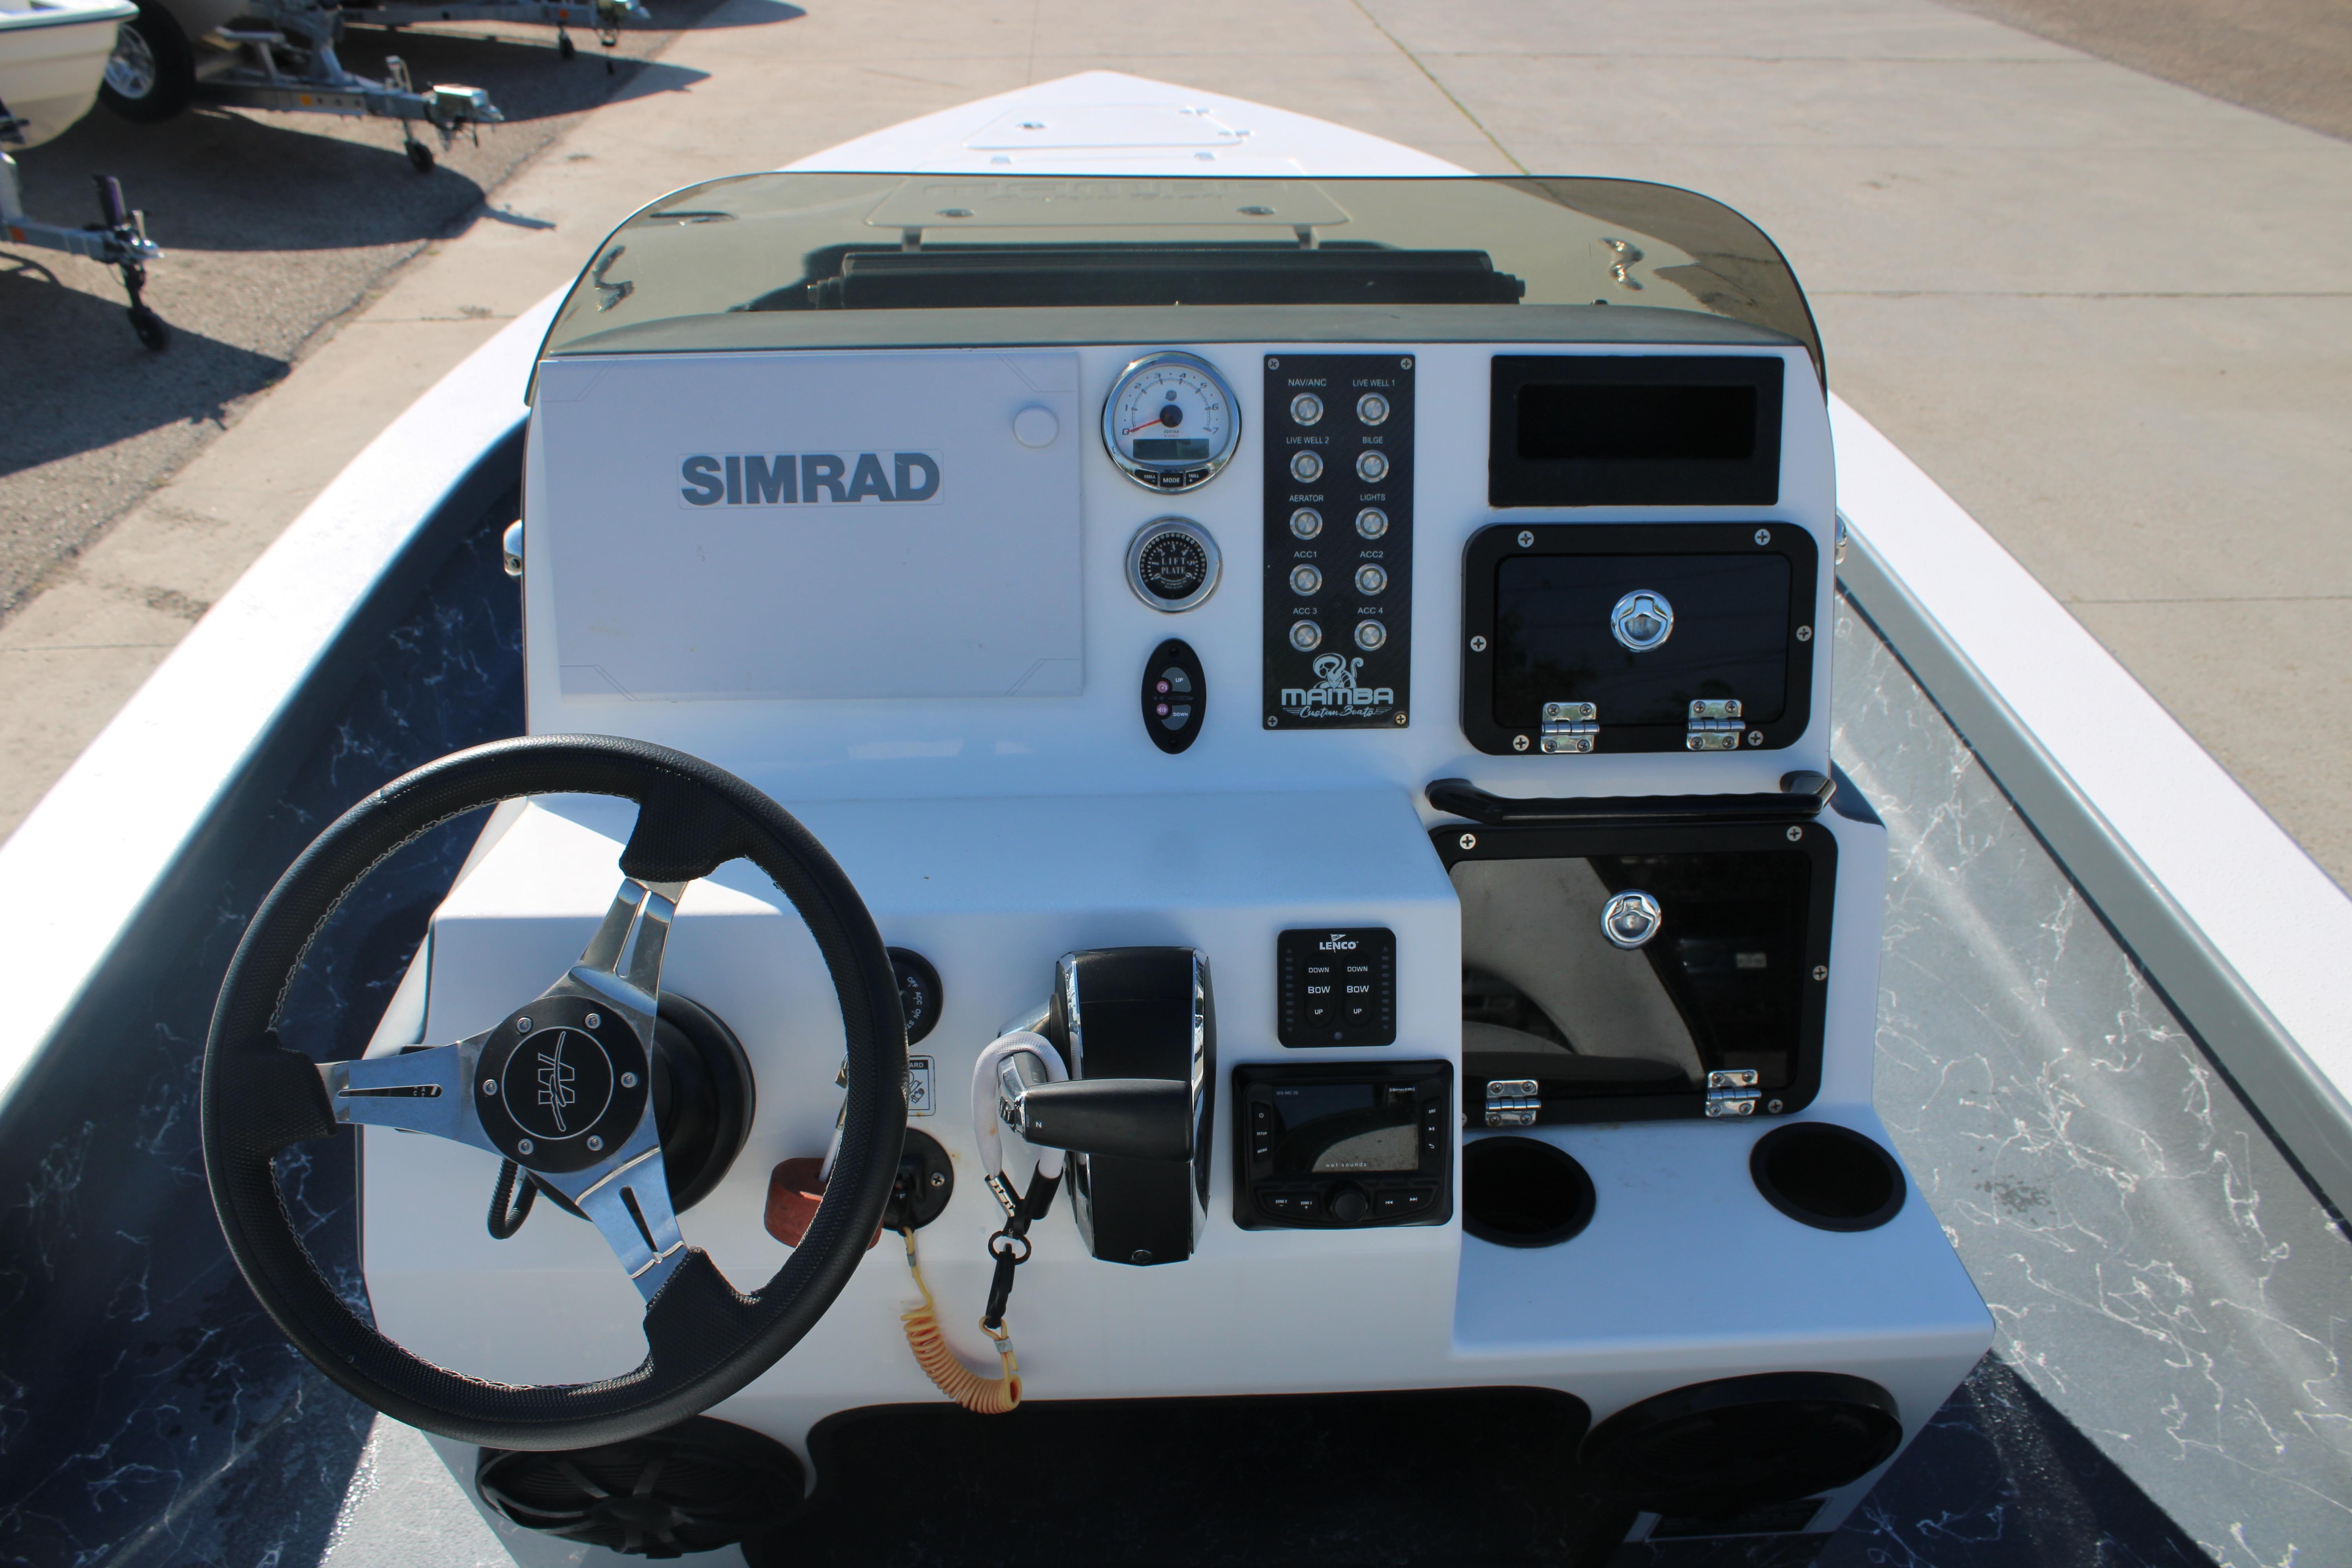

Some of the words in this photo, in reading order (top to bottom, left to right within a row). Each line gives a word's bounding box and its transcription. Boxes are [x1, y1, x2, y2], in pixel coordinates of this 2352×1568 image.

[681, 452, 940, 506] SIMRAD
[1171, 544, 1176, 552] 3
[1161, 557, 1186, 565] LIFT
[1161, 566, 1186, 575] PLATE
[1281, 688, 1394, 706] MAMBA
[1299, 705, 1339, 718] Custom
[1339, 705, 1374, 717] Boats
[907, 976, 918, 988] OFF
[913, 1009, 921, 1019] ON
[906, 1020, 915, 1029] ST
